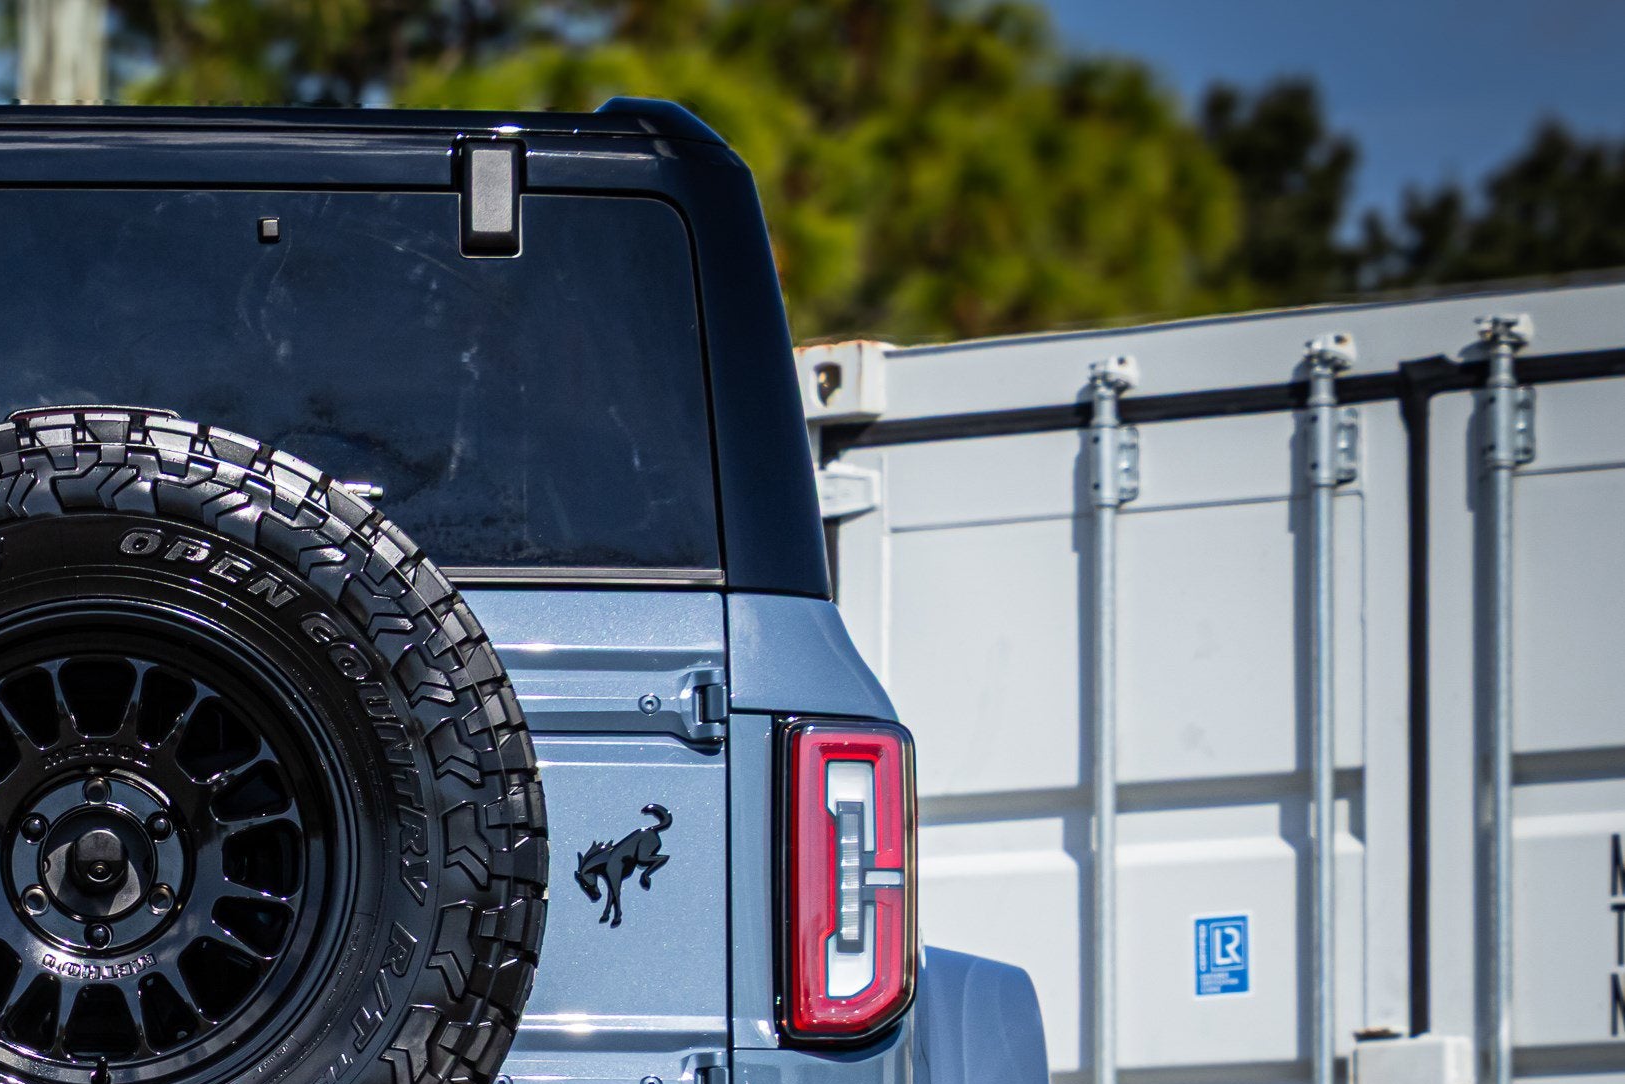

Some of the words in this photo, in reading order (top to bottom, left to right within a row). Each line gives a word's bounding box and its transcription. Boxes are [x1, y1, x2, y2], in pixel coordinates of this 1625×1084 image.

[119, 528, 303, 610] OPEN
[298, 610, 428, 906] COUNTRY
[351, 920, 420, 1054] R/T
